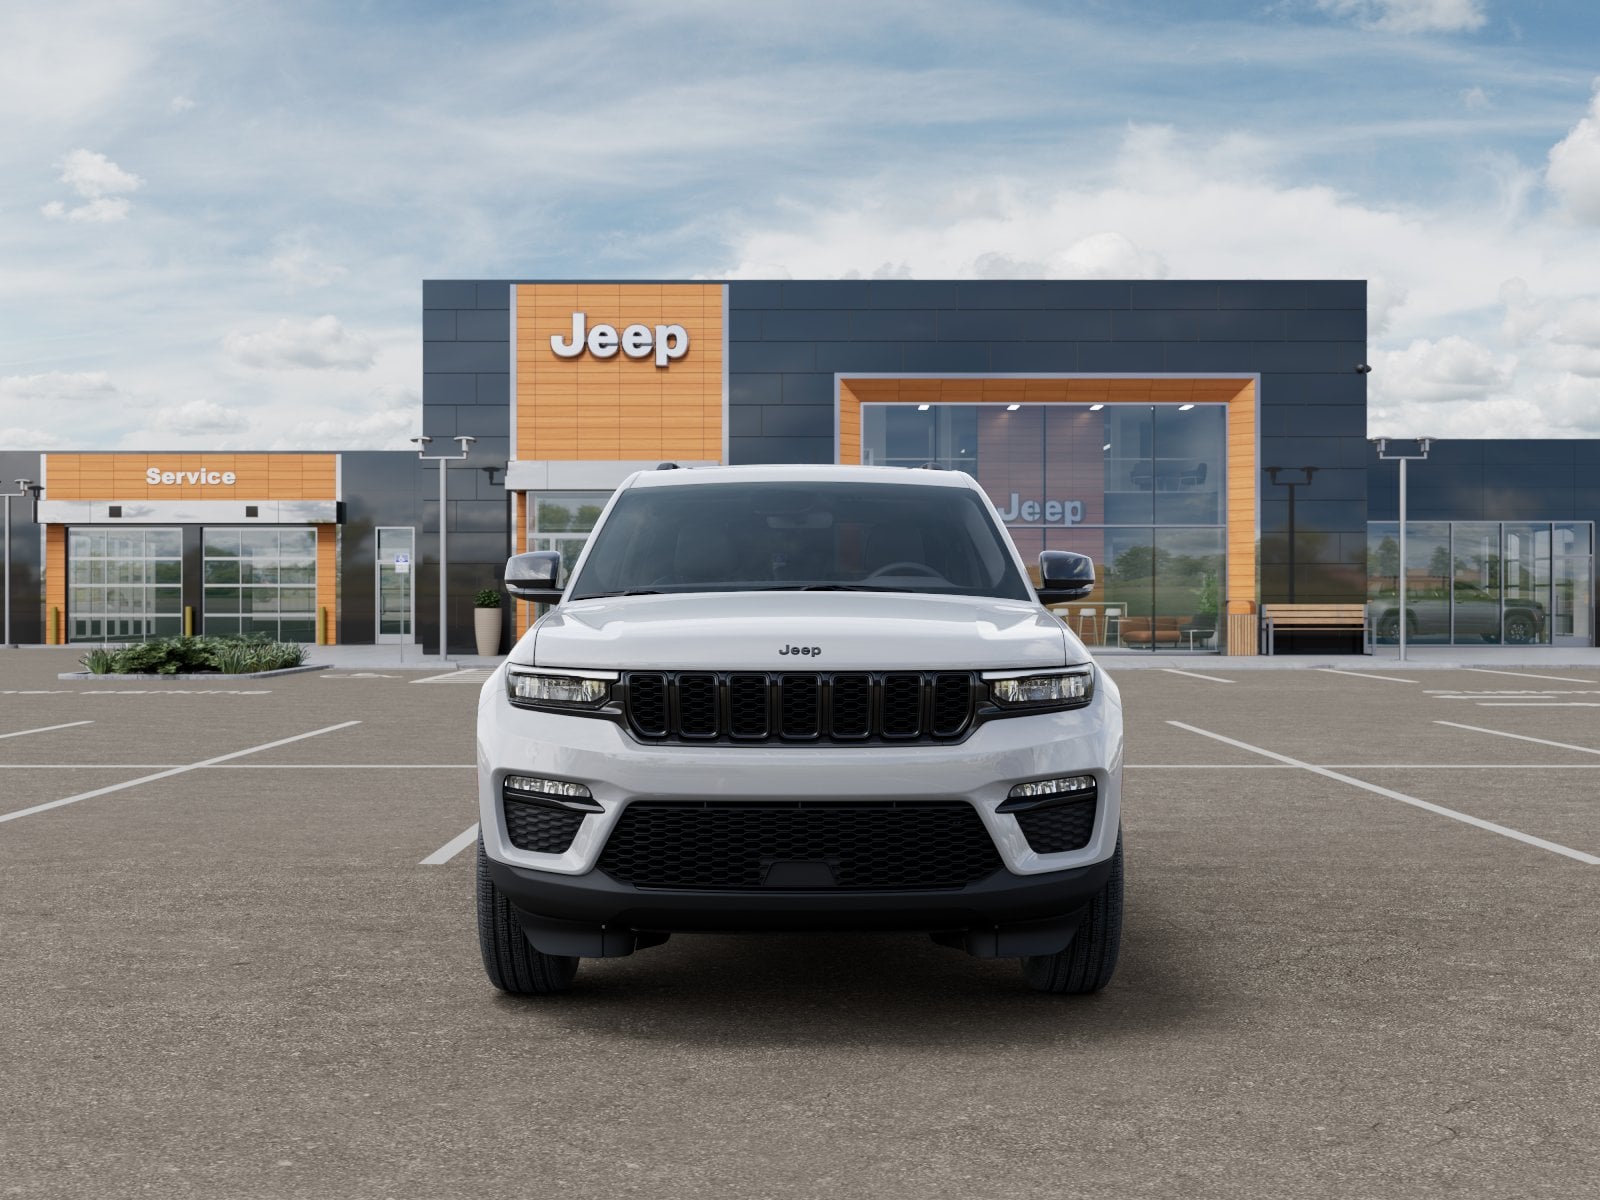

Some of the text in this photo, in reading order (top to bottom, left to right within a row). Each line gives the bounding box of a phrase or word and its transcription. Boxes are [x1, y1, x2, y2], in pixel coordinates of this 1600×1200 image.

[550, 312, 689, 368] Jeep
[146, 467, 236, 485] Service
[998, 493, 1083, 525] Jeep
[779, 644, 821, 657] Jeep
